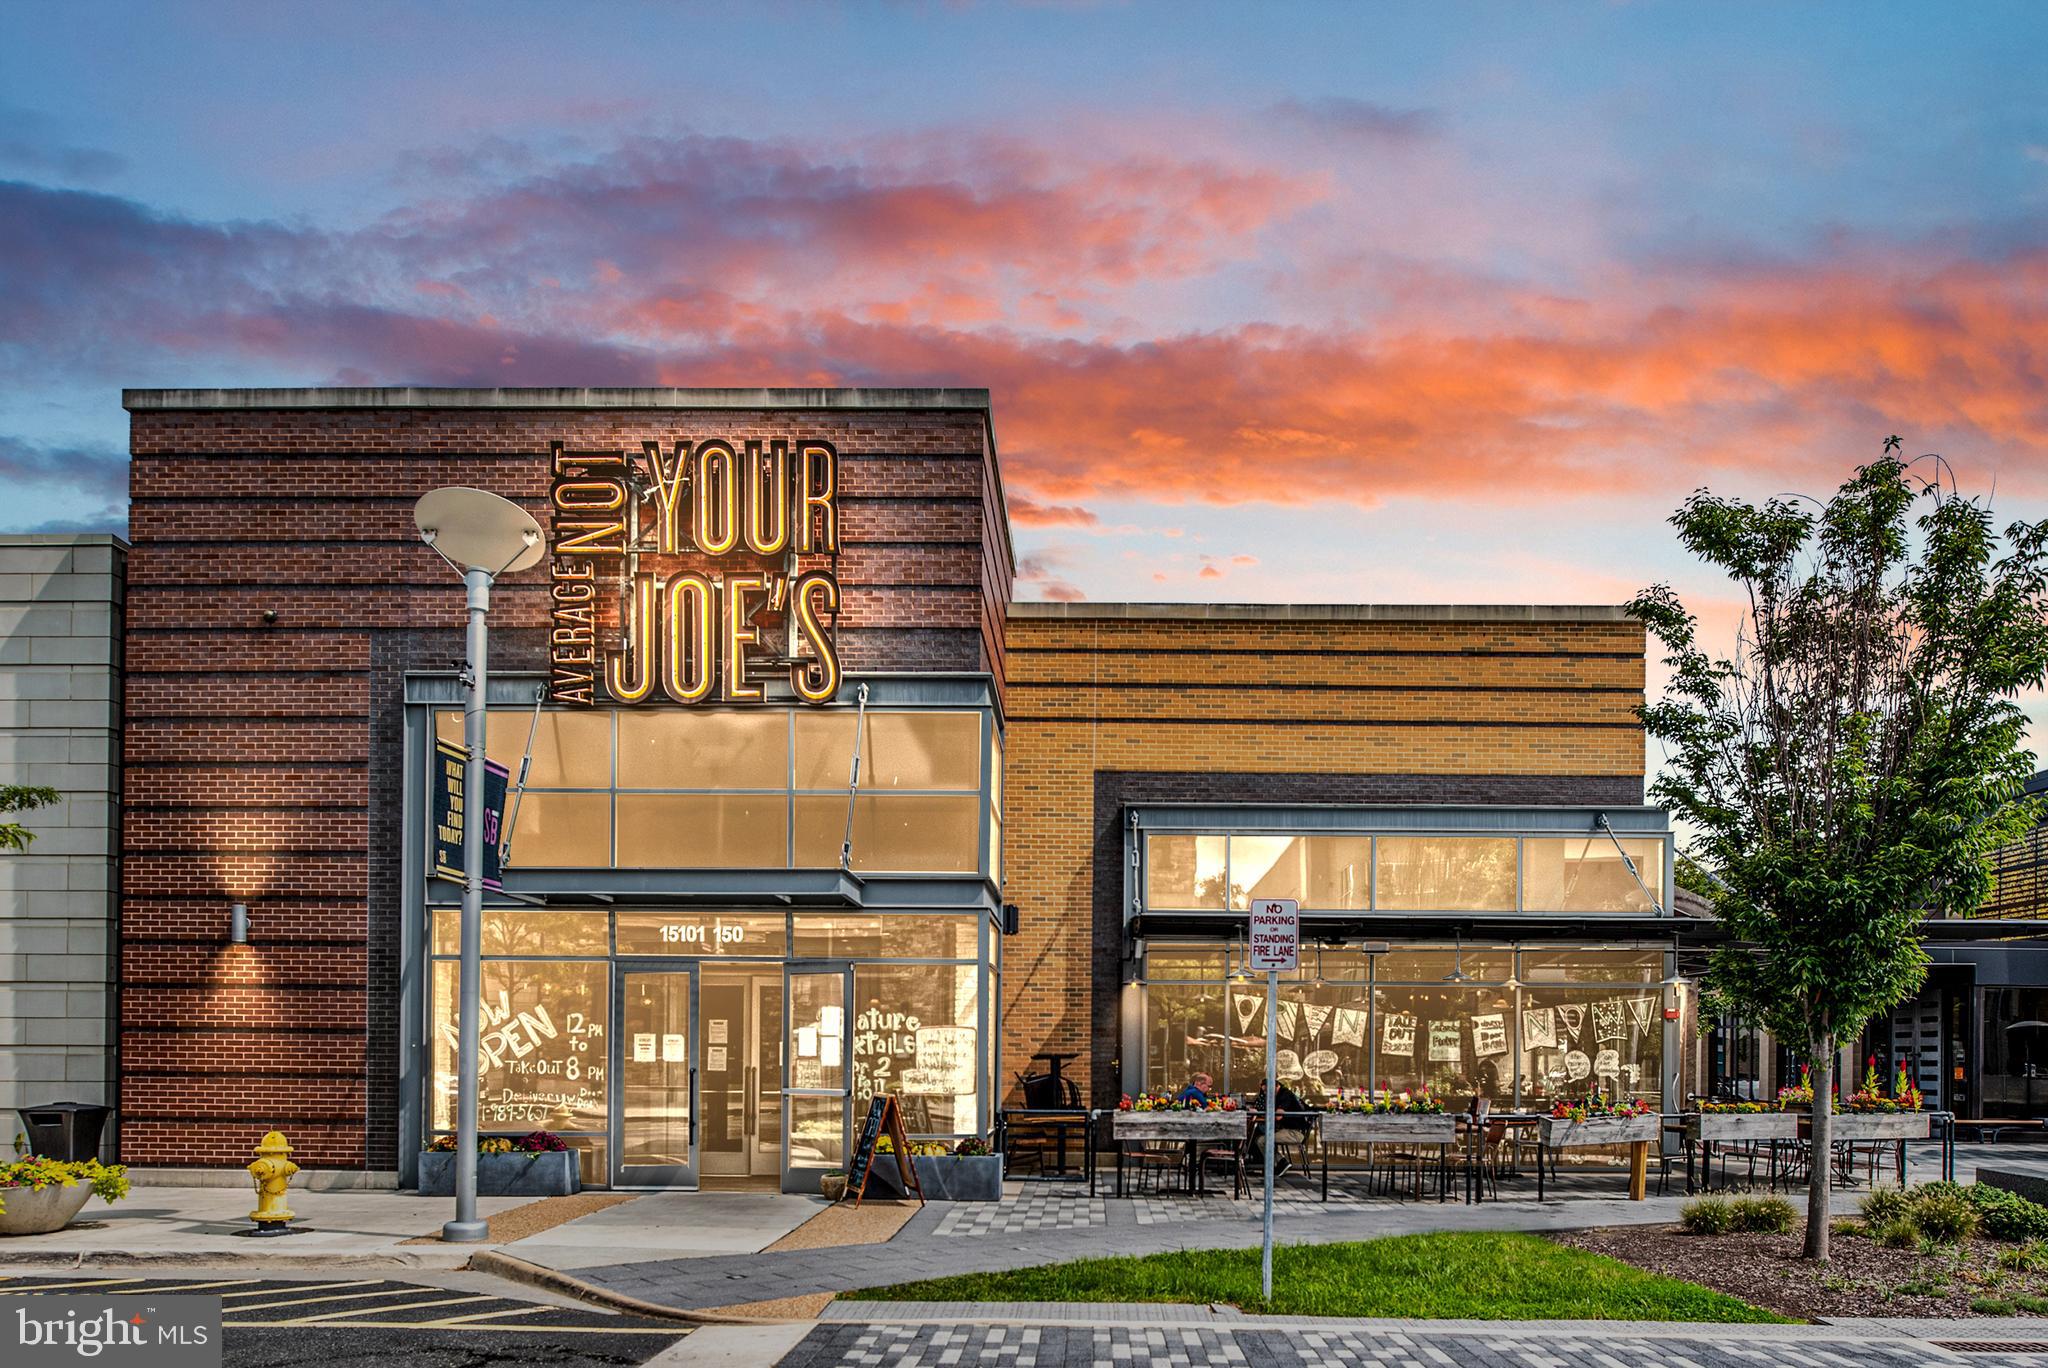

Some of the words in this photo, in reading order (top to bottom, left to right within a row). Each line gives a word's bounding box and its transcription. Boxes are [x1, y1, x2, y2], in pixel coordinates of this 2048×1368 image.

[550, 440, 628, 556] NOT
[641, 438, 842, 556] YOUR
[550, 558, 595, 706] AVERAGE
[604, 570, 842, 704] JOE'S
[446, 759, 464, 780] WHAT
[447, 776, 464, 797] WILL
[449, 794, 464, 813] YOU
[447, 810, 464, 829] FIND
[437, 824, 463, 846] TODAY?
[1266, 904, 1283, 914] NO
[1253, 915, 1295, 925] PARKING
[659, 924, 705, 943] 15101
[712, 924, 744, 943] 150
[1253, 933, 1295, 944] STANDING
[1253, 945, 1271, 957] FIRE
[1273, 945, 1295, 957] LANE
[566, 1013, 586, 1035] 12
[568, 1035, 588, 1052] to
[565, 1056, 580, 1081] 8
